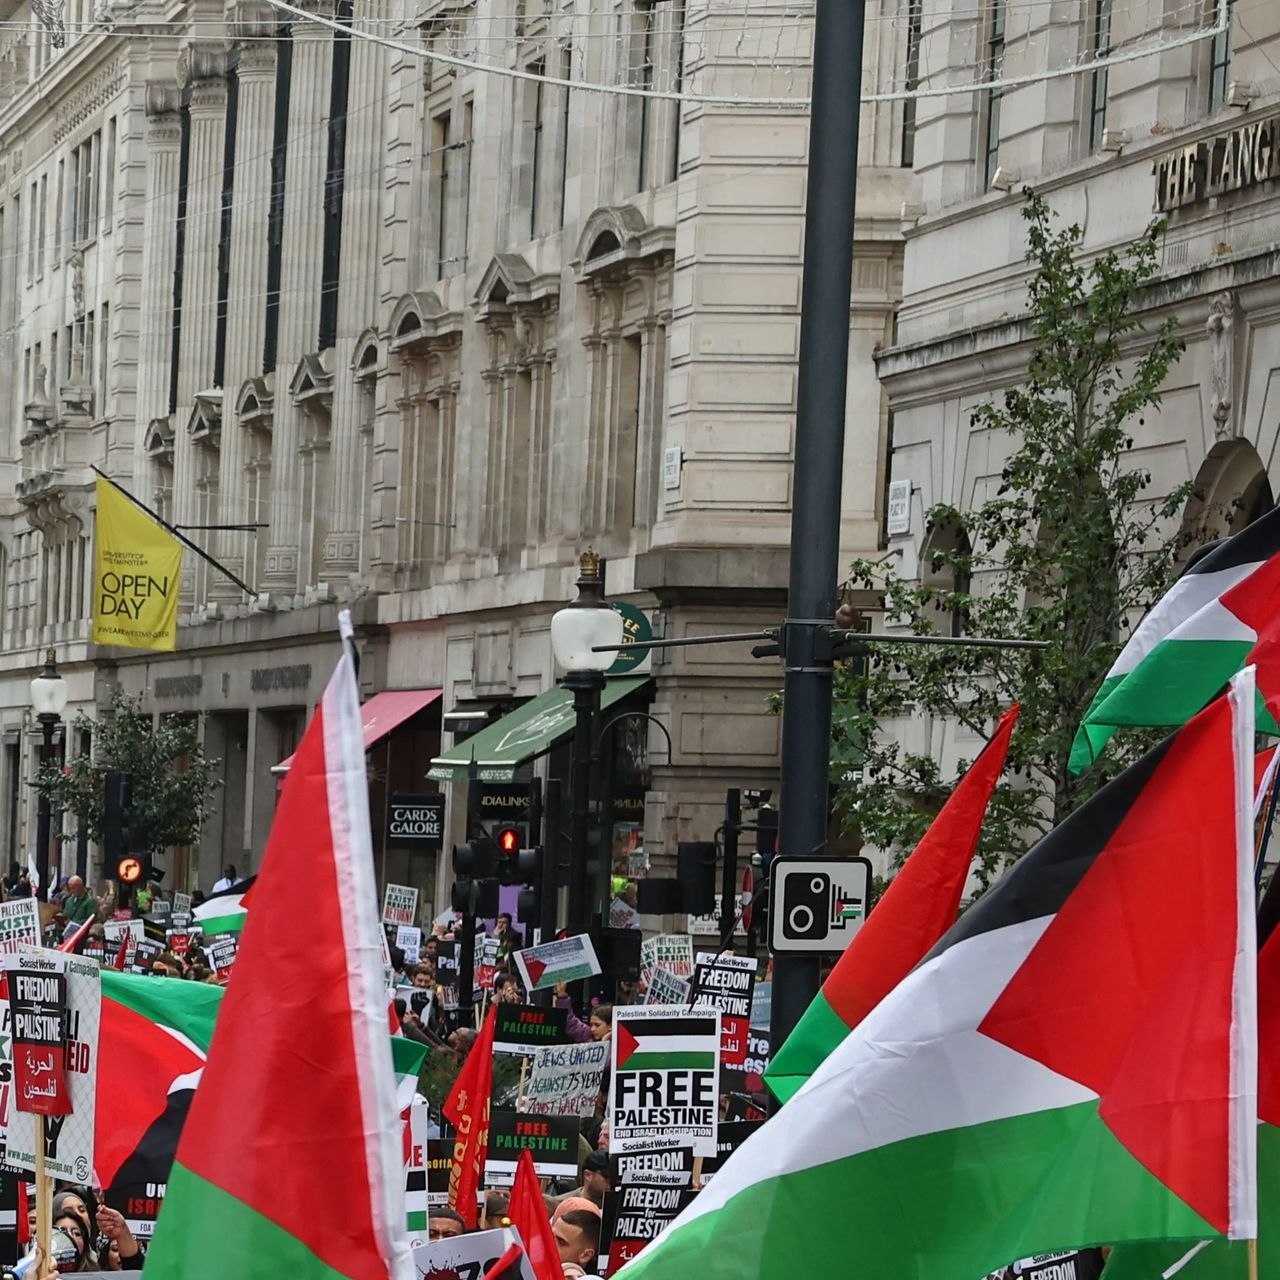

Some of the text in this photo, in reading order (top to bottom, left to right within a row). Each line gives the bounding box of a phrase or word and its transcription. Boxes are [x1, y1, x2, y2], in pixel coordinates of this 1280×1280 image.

[1151, 118, 1280, 213] THE LANG
[102, 572, 168, 597] OPEN
[100, 594, 146, 619] DAY
[394, 809, 437, 821] CARDS
[390, 821, 440, 834] GALORE
[617, 1009, 717, 1018] Palestine Solidarity Campaign
[538, 1046, 604, 1067] JEWS UNITED
[530, 1077, 565, 1094] AGAINST
[568, 1072, 579, 1089] 75
[615, 1071, 714, 1108] FREE
[614, 1108, 713, 1127] PALESTINE
[615, 1129, 631, 1138] END
[663, 1127, 712, 1137] OCCUPATION
